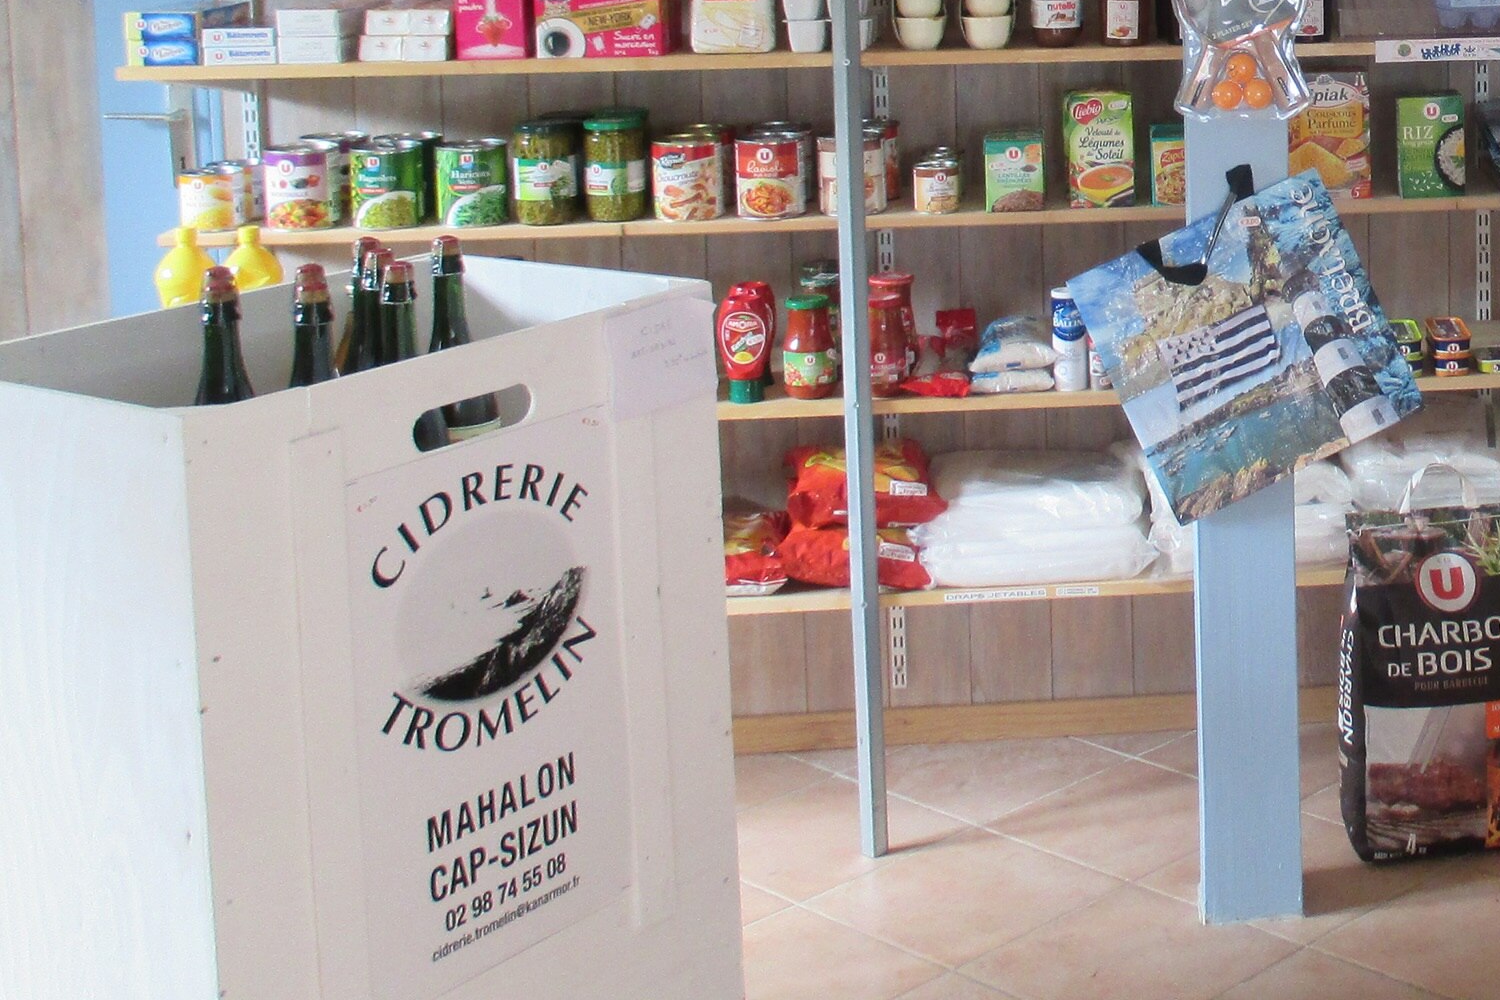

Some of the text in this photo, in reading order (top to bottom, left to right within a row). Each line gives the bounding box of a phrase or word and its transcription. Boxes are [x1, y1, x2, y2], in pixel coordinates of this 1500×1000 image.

[1047, 1, 1076, 12] nutella
[613, 31, 642, 41] Sucre
[1216, 24, 1240, 39] PLAYER
[613, 41, 656, 49] morceaux
[1074, 101, 1102, 120] Liebig
[1307, 108, 1357, 118] Couscous
[1085, 127, 1113, 137] Velouté
[1403, 125, 1434, 140] RIZ
[1078, 136, 1125, 151] Légumes
[1095, 148, 1124, 161] Soleil
[747, 160, 784, 174] Ravioli
[451, 170, 491, 180] Haricots
[1352, 186, 1360, 198] 5
[370, 463, 589, 590] CIDRERIE
[1429, 566, 1465, 600] U
[946, 593, 985, 601] DRAPS
[989, 590, 1046, 599] JETABLES
[1387, 646, 1493, 677] DE BOIS
[380, 615, 597, 752] TROMELIN
[1414, 675, 1489, 691] POUR BARBECUE
[427, 751, 577, 853] MAHALON
[430, 800, 578, 902] CAP-SIZUN
[445, 852, 567, 932] 02 98 74 55 08
